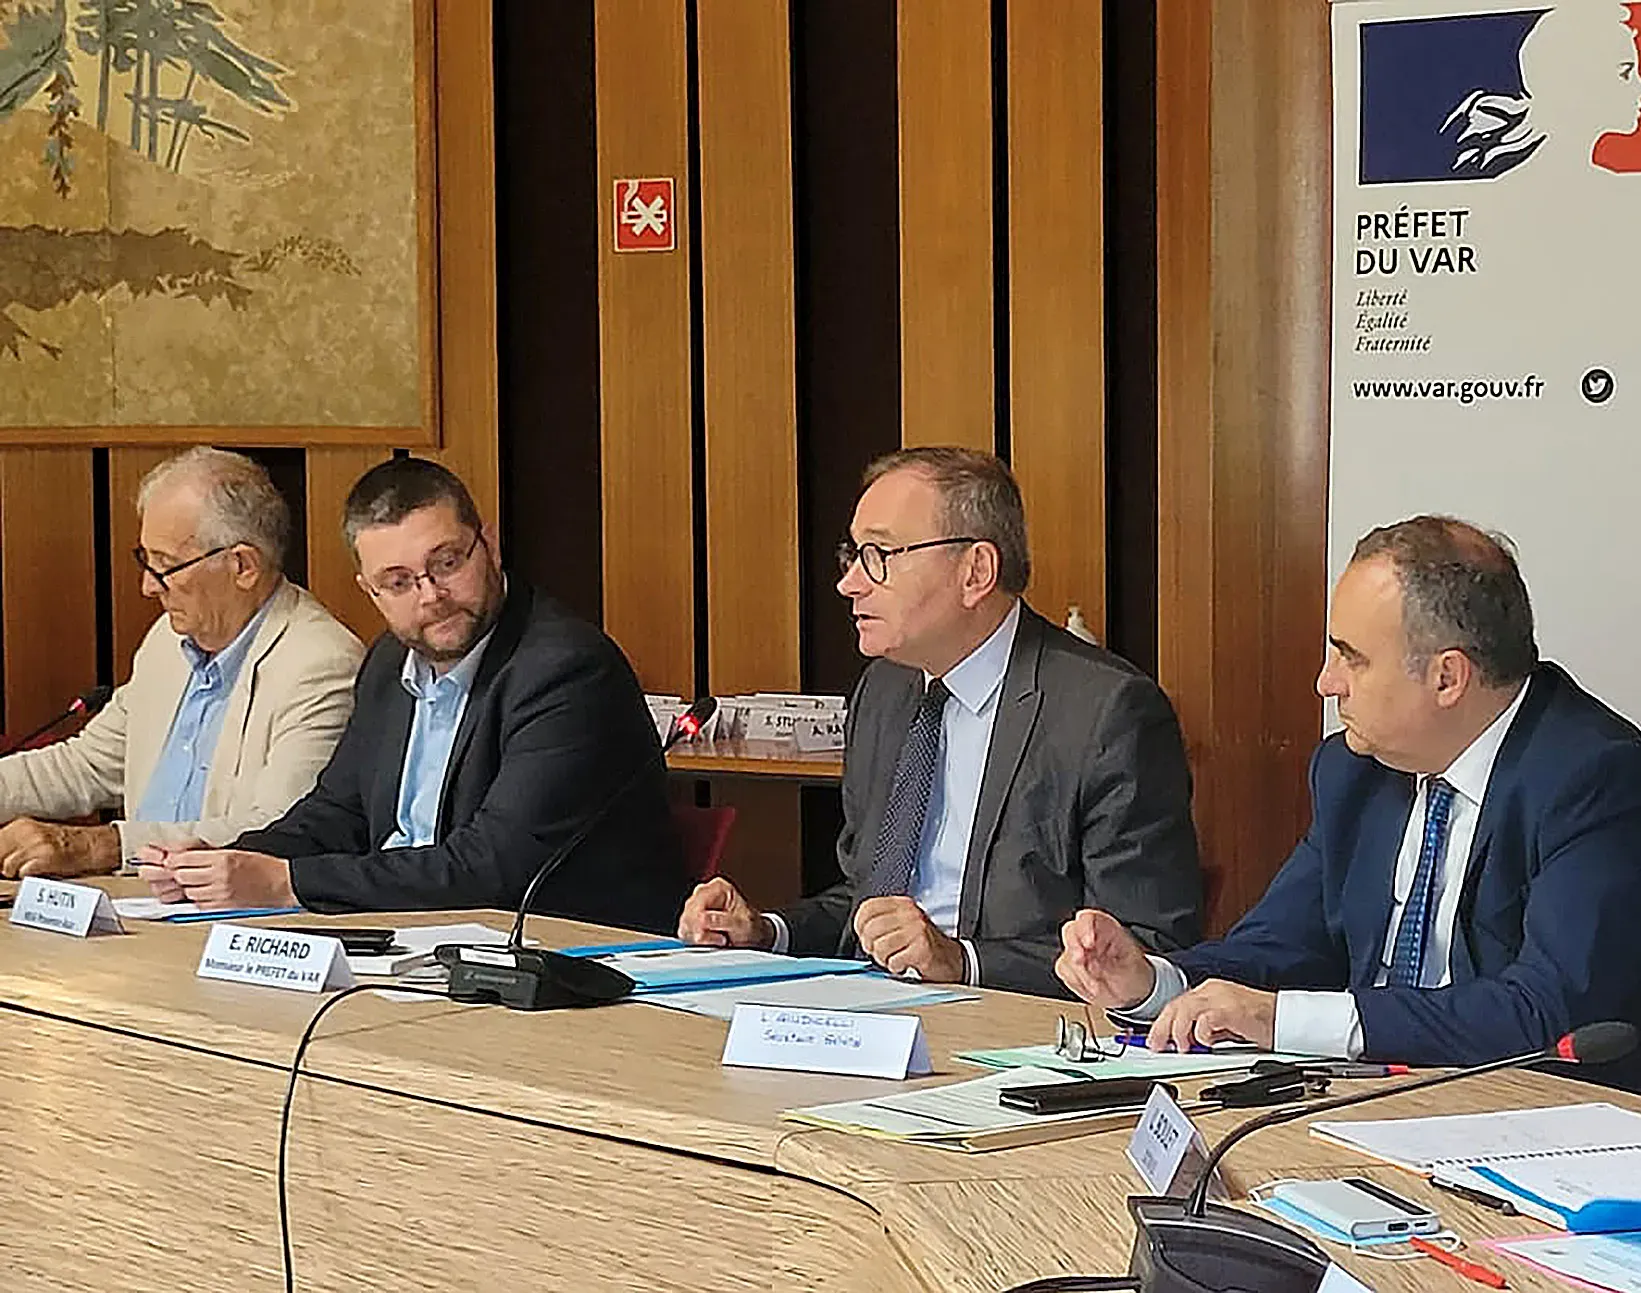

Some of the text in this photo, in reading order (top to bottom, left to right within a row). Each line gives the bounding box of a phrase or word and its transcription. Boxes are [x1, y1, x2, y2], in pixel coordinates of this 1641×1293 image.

[1357, 205, 1469, 240] PRÉFET
[1356, 246, 1477, 274] DU VAR
[1356, 289, 1408, 307] Liberté
[1355, 335, 1432, 352] Fraternité
[1353, 375, 1544, 404] www.var.gouv.fr
[245, 936, 311, 959] RICHARD
